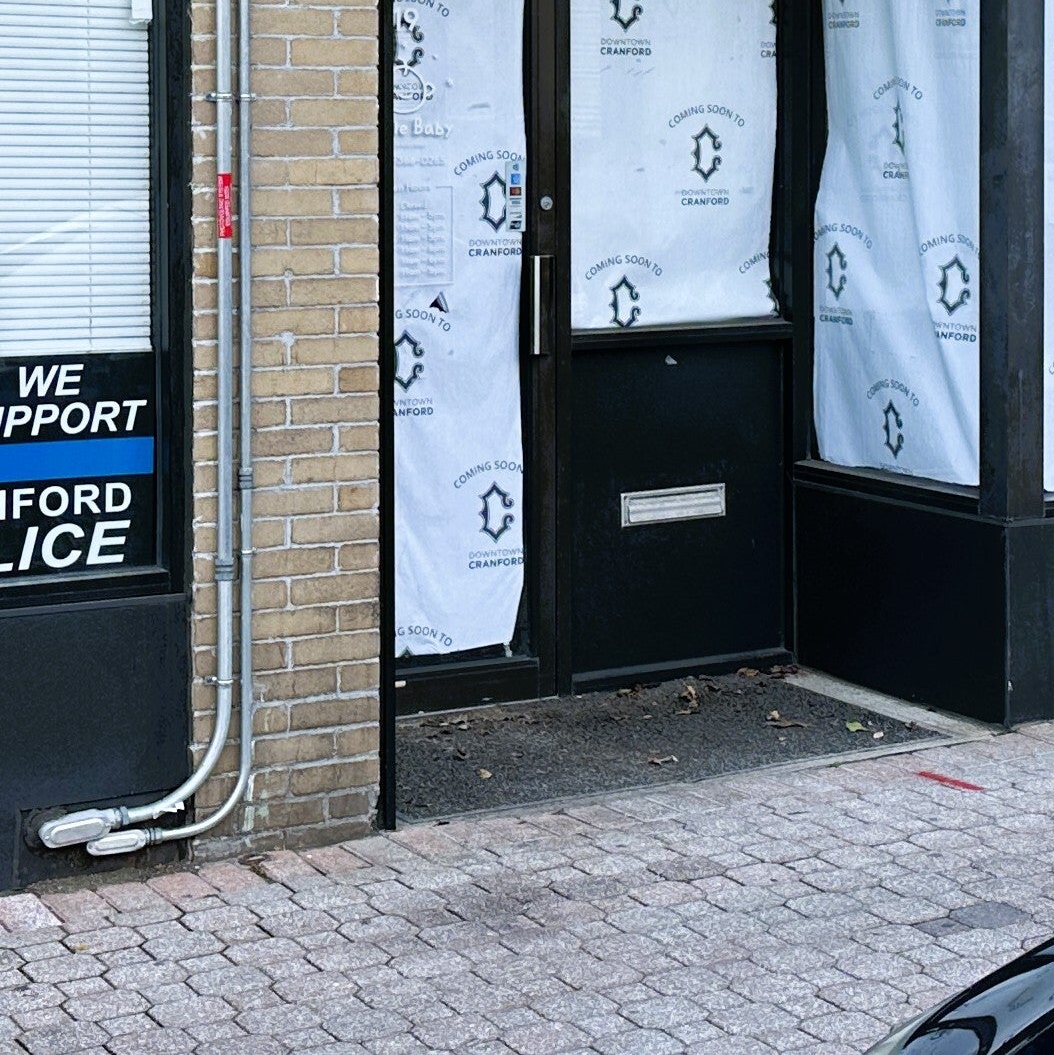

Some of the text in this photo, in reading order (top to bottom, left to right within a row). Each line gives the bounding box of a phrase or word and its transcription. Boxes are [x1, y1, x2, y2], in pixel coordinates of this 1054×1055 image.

[600, 47, 652, 56] CRANFORD
[668, 104, 745, 128] COMING SOON TO
[454, 150, 494, 176] COMING
[681, 197, 729, 206] CRANFORD
[469, 248, 523, 257] CRANFORD
[585, 255, 663, 280] COMING SOON TO
[19, 363, 84, 398] WE
[0, 399, 147, 437] PPORT
[453, 461, 492, 489] COMING
[0, 482, 132, 520] FORD
[469, 557, 524, 569] CRANFORD
